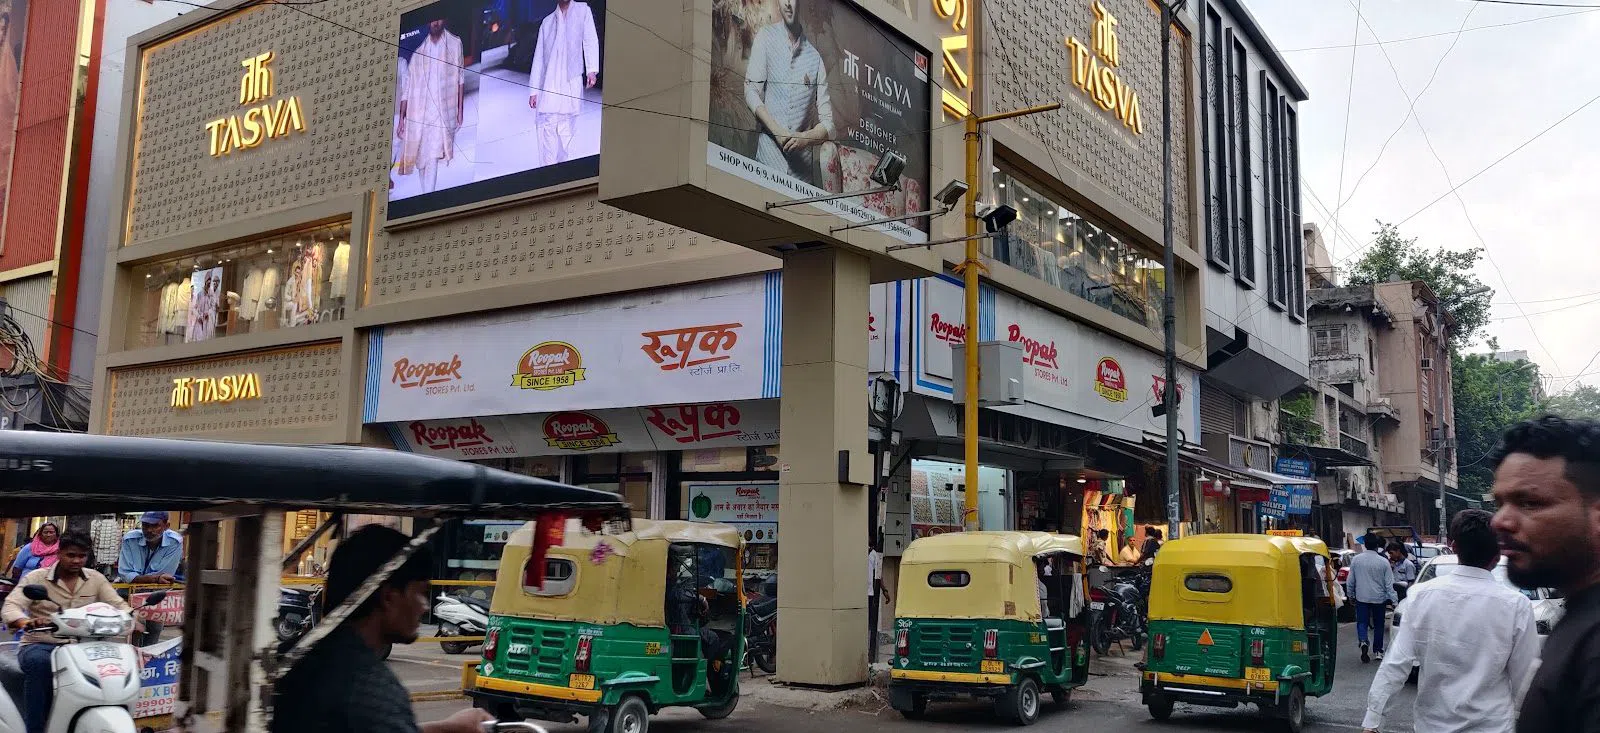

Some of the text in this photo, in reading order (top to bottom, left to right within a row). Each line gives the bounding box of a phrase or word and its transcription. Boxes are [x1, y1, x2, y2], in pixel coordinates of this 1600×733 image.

[864, 63, 912, 109] TASVA
[1066, 35, 1143, 135] TASVA
[205, 95, 305, 157] TASVA
[859, 118, 897, 145] DESIGNER
[847, 127, 885, 153] WEDDING
[719, 151, 741, 167] SHOP
[771, 174, 794, 190] AJMAL
[795, 183, 814, 198] KHAN
[528, 348, 571, 369] Roopak
[640, 322, 743, 371] रूपक
[391, 353, 463, 388] Roopak
[526, 375, 570, 387] SINCE 1958
[1034, 368, 1052, 382] STORES
[196, 373, 262, 403] TASVA
[425, 386, 450, 396] STORES
[409, 419, 493, 449] Roopak
[551, 419, 600, 437] Roopak
[461, 446, 489, 456] STORES
[562, 440, 587, 448] SINCE
[735, 487, 760, 497] Roopak
[1250, 628, 1265, 636] CNG
